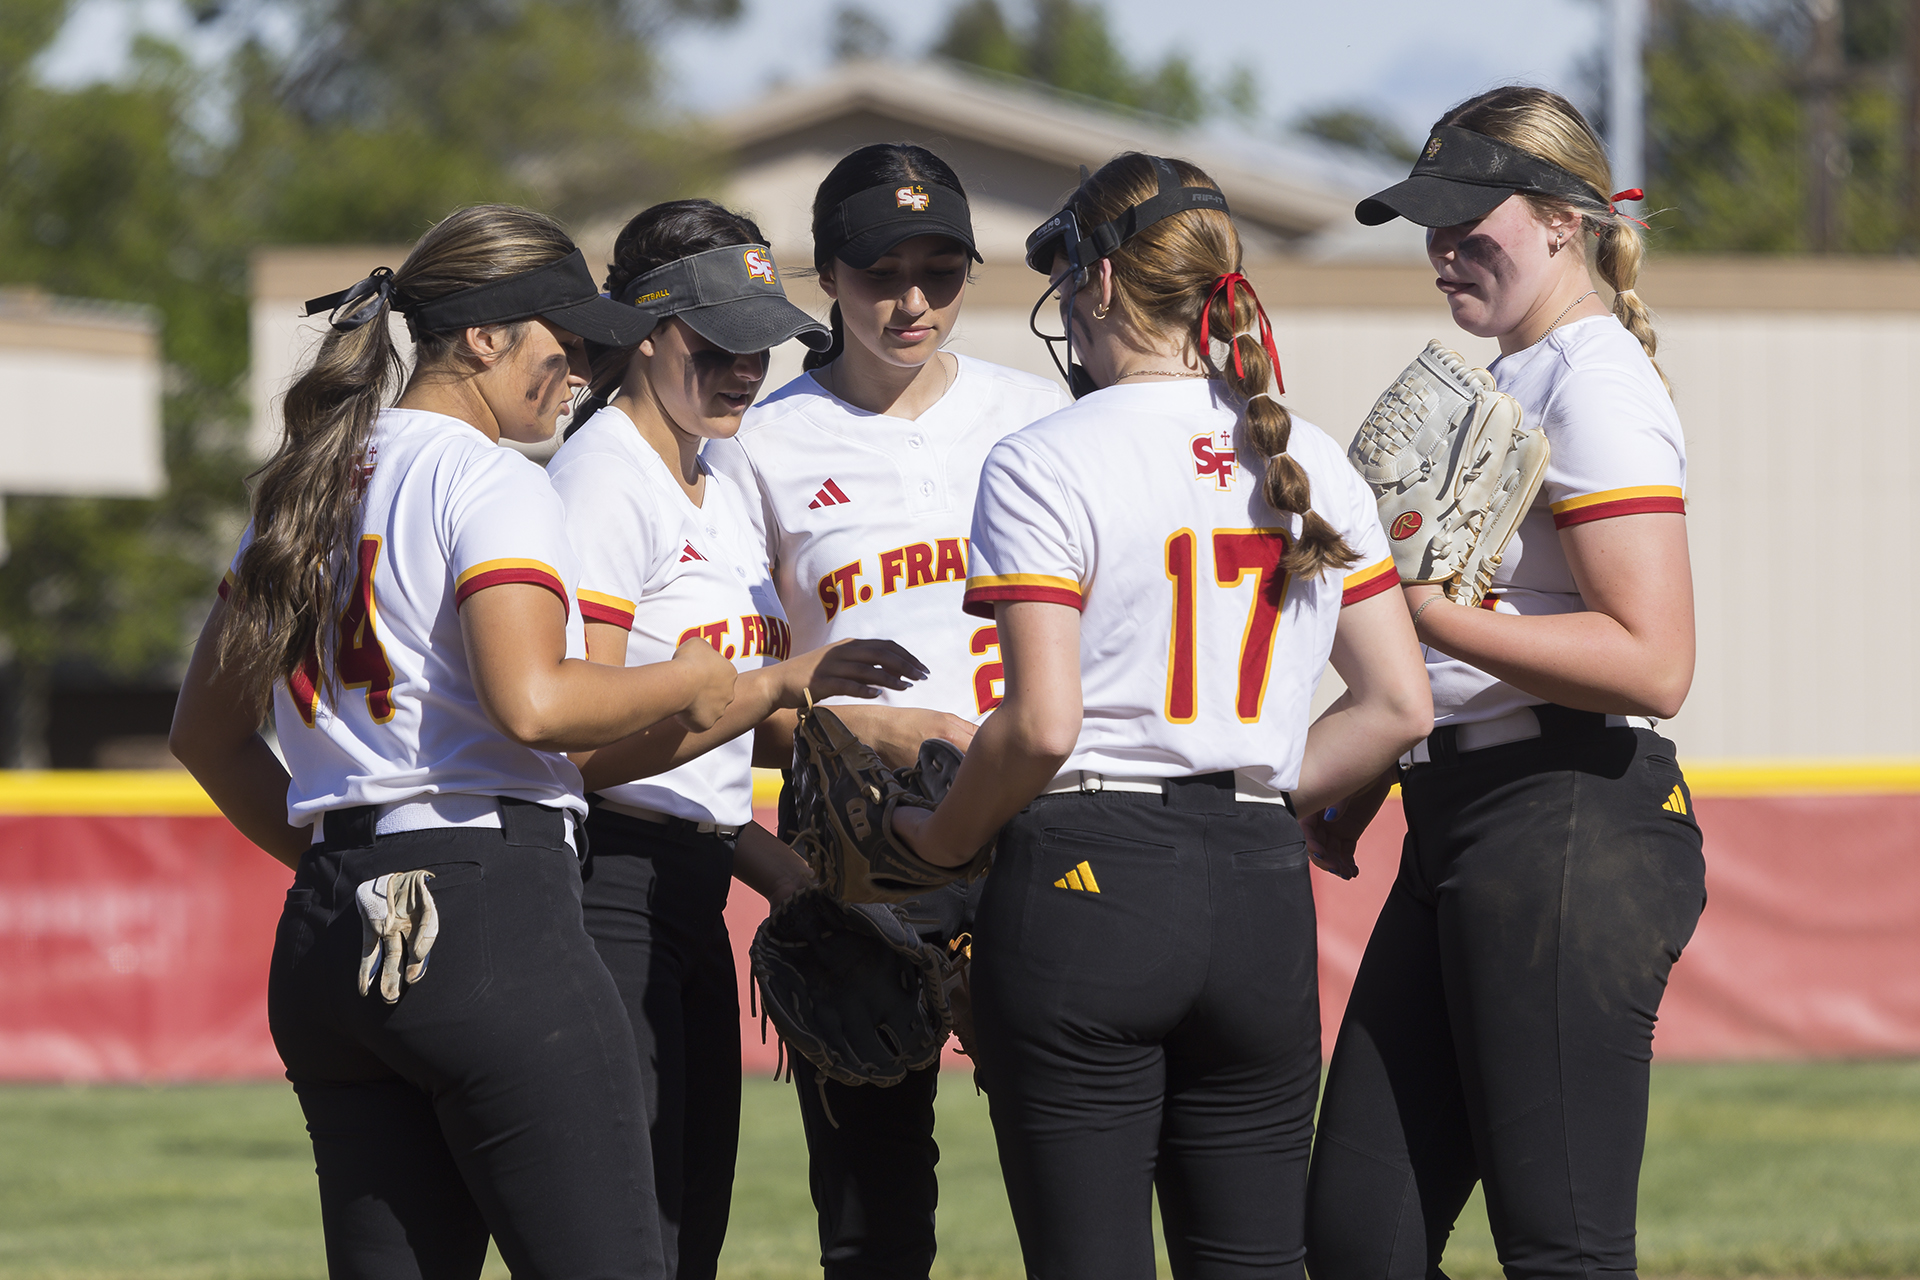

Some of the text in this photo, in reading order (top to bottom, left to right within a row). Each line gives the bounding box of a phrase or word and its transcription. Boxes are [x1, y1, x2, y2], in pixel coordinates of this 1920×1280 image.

[895, 186, 930, 211] SF
[743, 248, 776, 284] SF
[1189, 431, 1239, 491] SF
[817, 537, 971, 624] ST. FRA
[1164, 527, 1294, 725] 17
